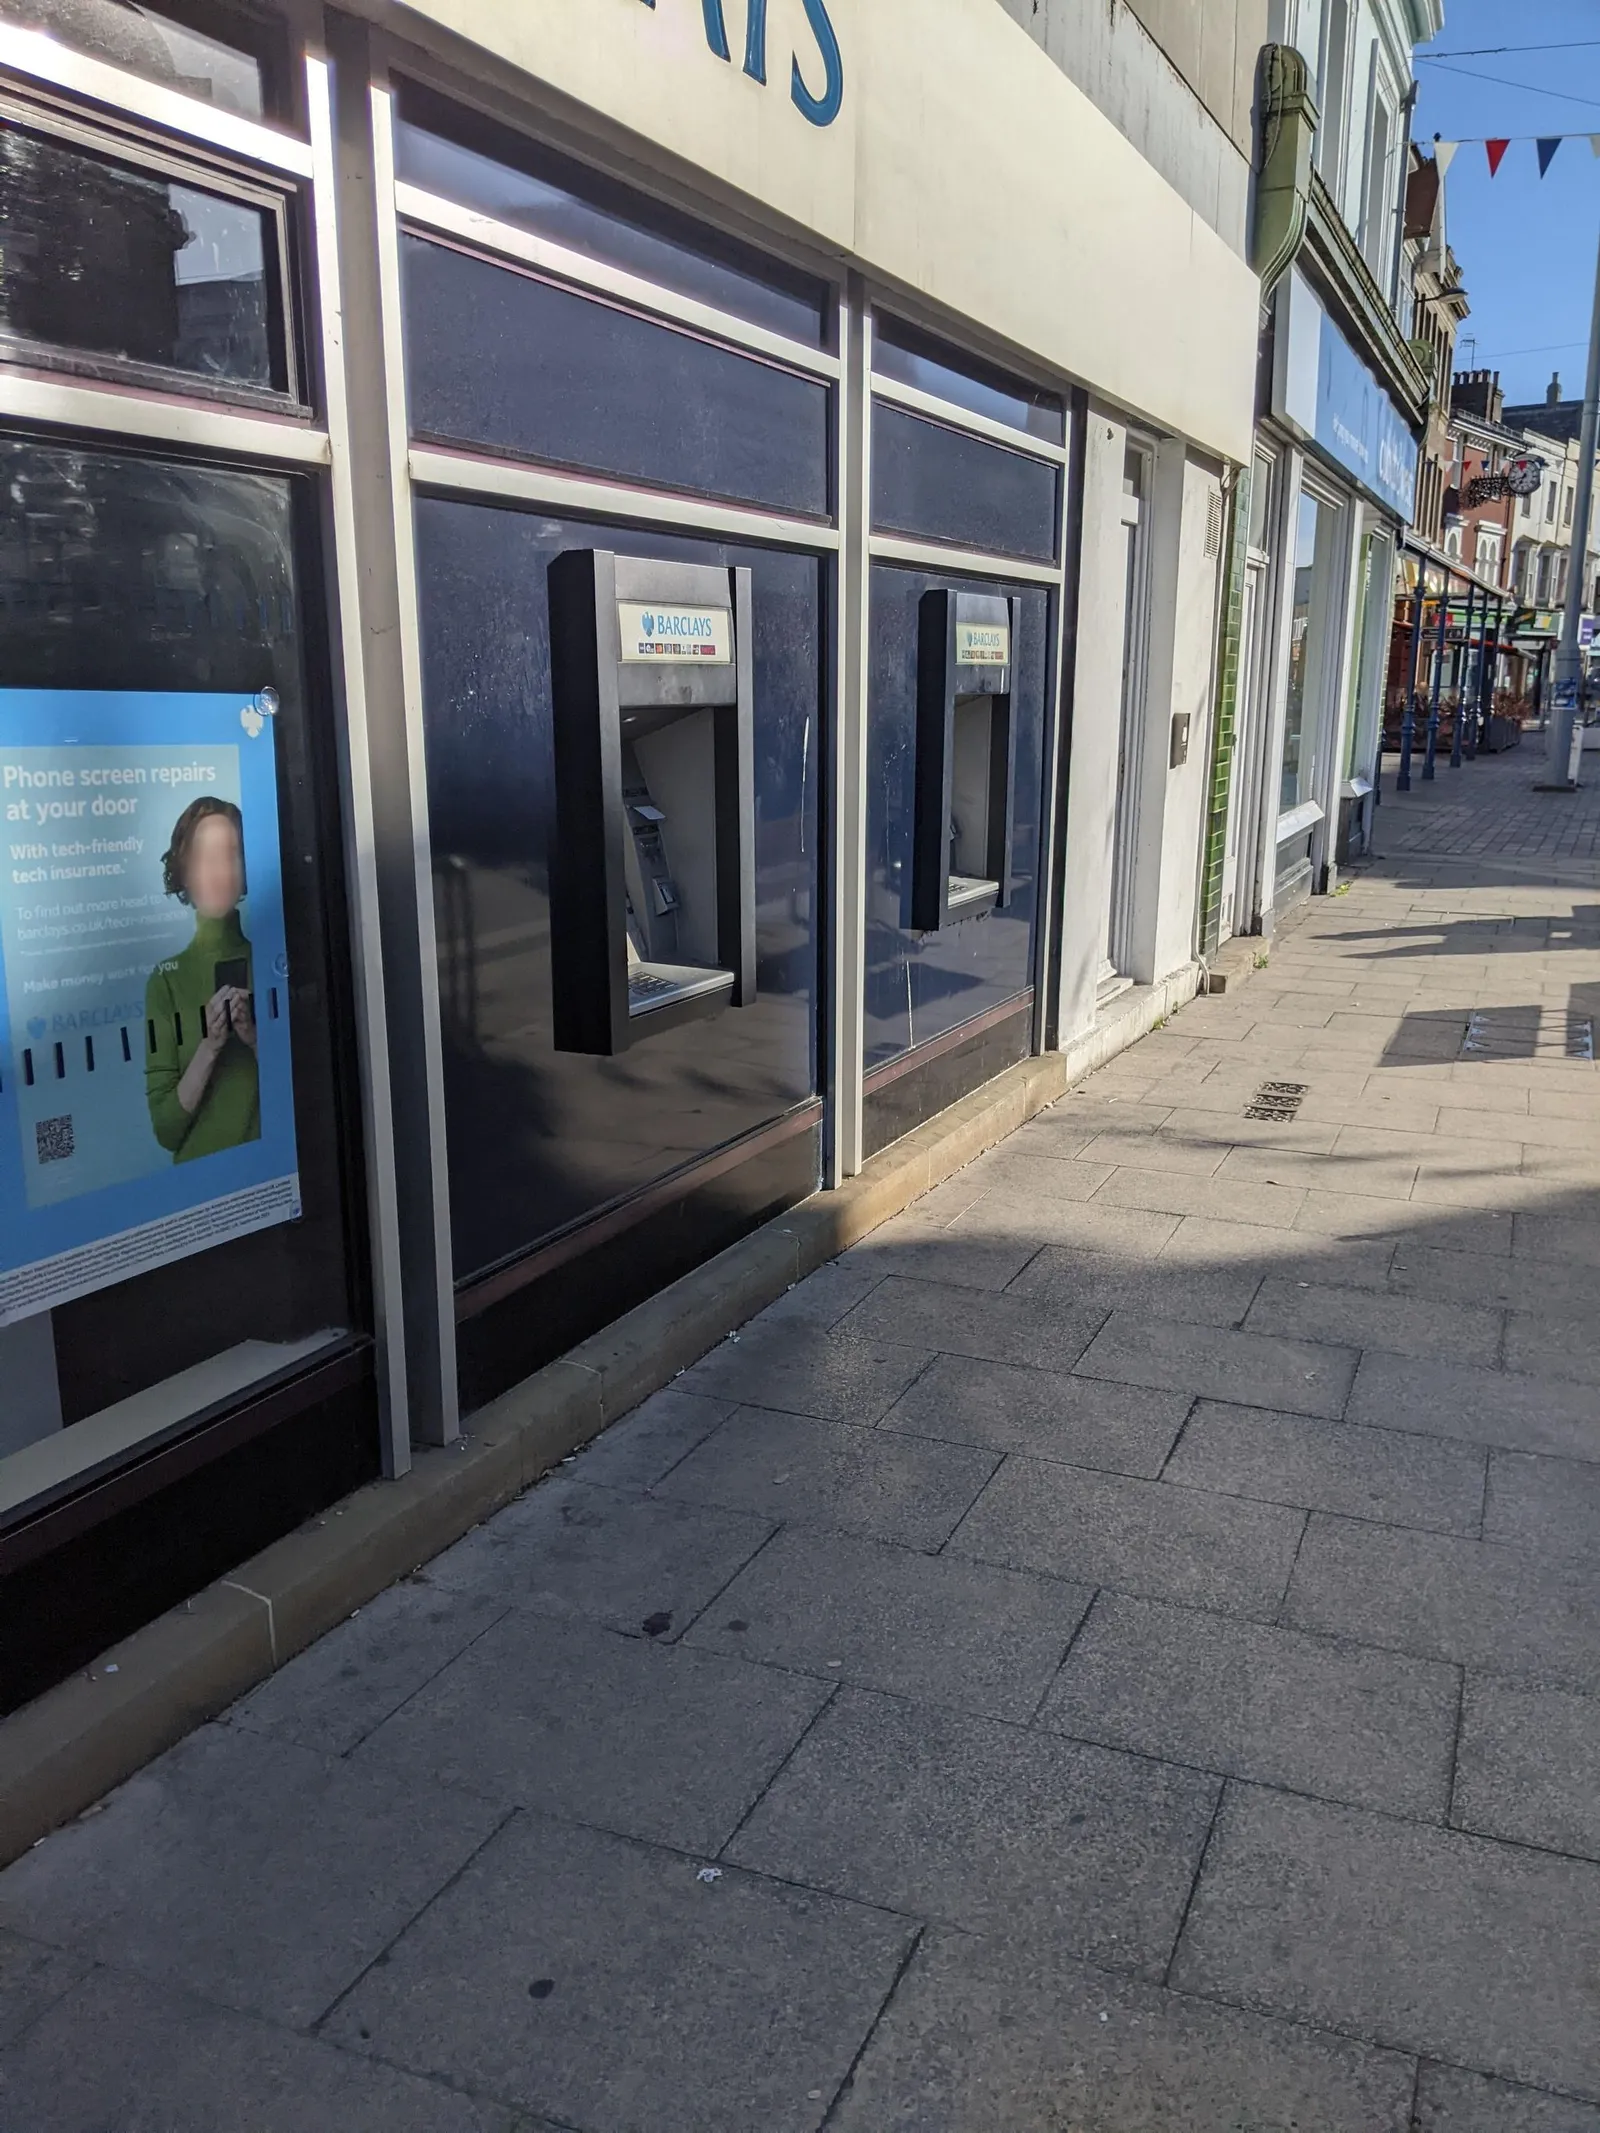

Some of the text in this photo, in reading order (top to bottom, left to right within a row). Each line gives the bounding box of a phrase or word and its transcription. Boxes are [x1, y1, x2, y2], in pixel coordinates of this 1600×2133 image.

[657, 615, 712, 637] BARCLAYS
[973, 631, 1000, 647] BARCLAYS
[3, 761, 216, 789] Phone screen repairs
[6, 793, 138, 826] at your door
[9, 835, 144, 860] With tech-friendly
[12, 865, 47, 884] tech
[15, 907, 33, 921] To
[34, 903, 60, 920] find
[62, 903, 85, 917] out
[86, 899, 119, 914] more
[120, 894, 148, 911] head
[23, 976, 59, 994] Make
[60, 972, 104, 987] money
[107, 965, 136, 981] work
[157, 959, 179, 976] you
[52, 1000, 144, 1032] BARCLAYS
